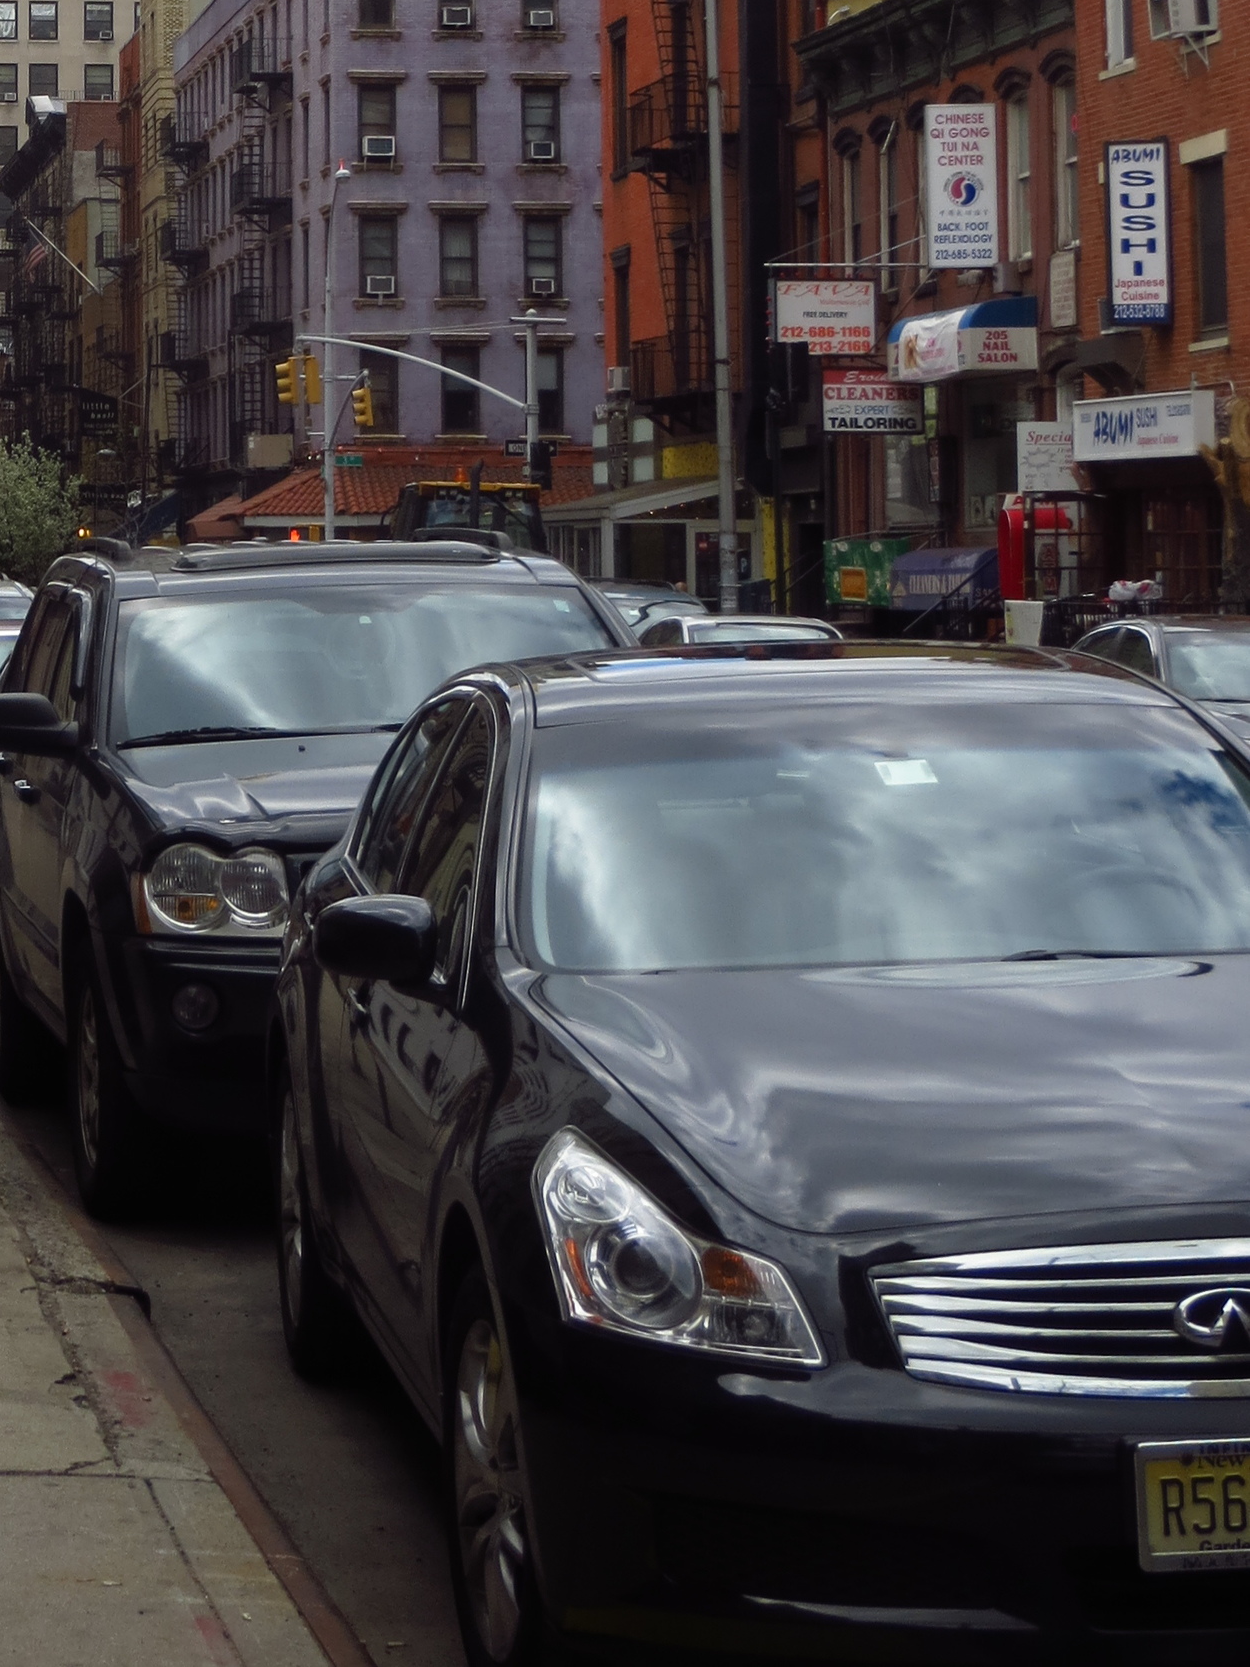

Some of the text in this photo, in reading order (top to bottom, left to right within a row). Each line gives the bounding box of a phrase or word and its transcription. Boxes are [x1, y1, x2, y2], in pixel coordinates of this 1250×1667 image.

[935, 114, 985, 125] CHINESE
[930, 127, 990, 139] QI GONG
[940, 141, 979, 152] TUI NA
[938, 155, 984, 166] CENTER
[1111, 148, 1161, 164] ABUMI
[965, 222, 989, 231] FOOT
[1119, 170, 1156, 276] SUSHI
[934, 234, 992, 244] REFLEXOLOGY
[936, 249, 992, 259] 212-685-5322
[1115, 279, 1165, 289] Japanese
[1121, 291, 1160, 301] Cuisine
[1114, 305, 1165, 318] 212-532-8788
[781, 326, 870, 338] 212-686-1166
[985, 331, 1008, 340] 205
[983, 341, 1010, 351] NAIL
[978, 353, 1018, 363] SALON
[824, 387, 920, 401] CLEANERS
[855, 405, 889, 414] EXPERT
[828, 417, 917, 429] TAILORING
[1093, 410, 1133, 446] ABUMI
[1136, 406, 1158, 428] SUSHI
[1198, 1454, 1245, 1468] New
[1160, 1474, 1248, 1537] R56
